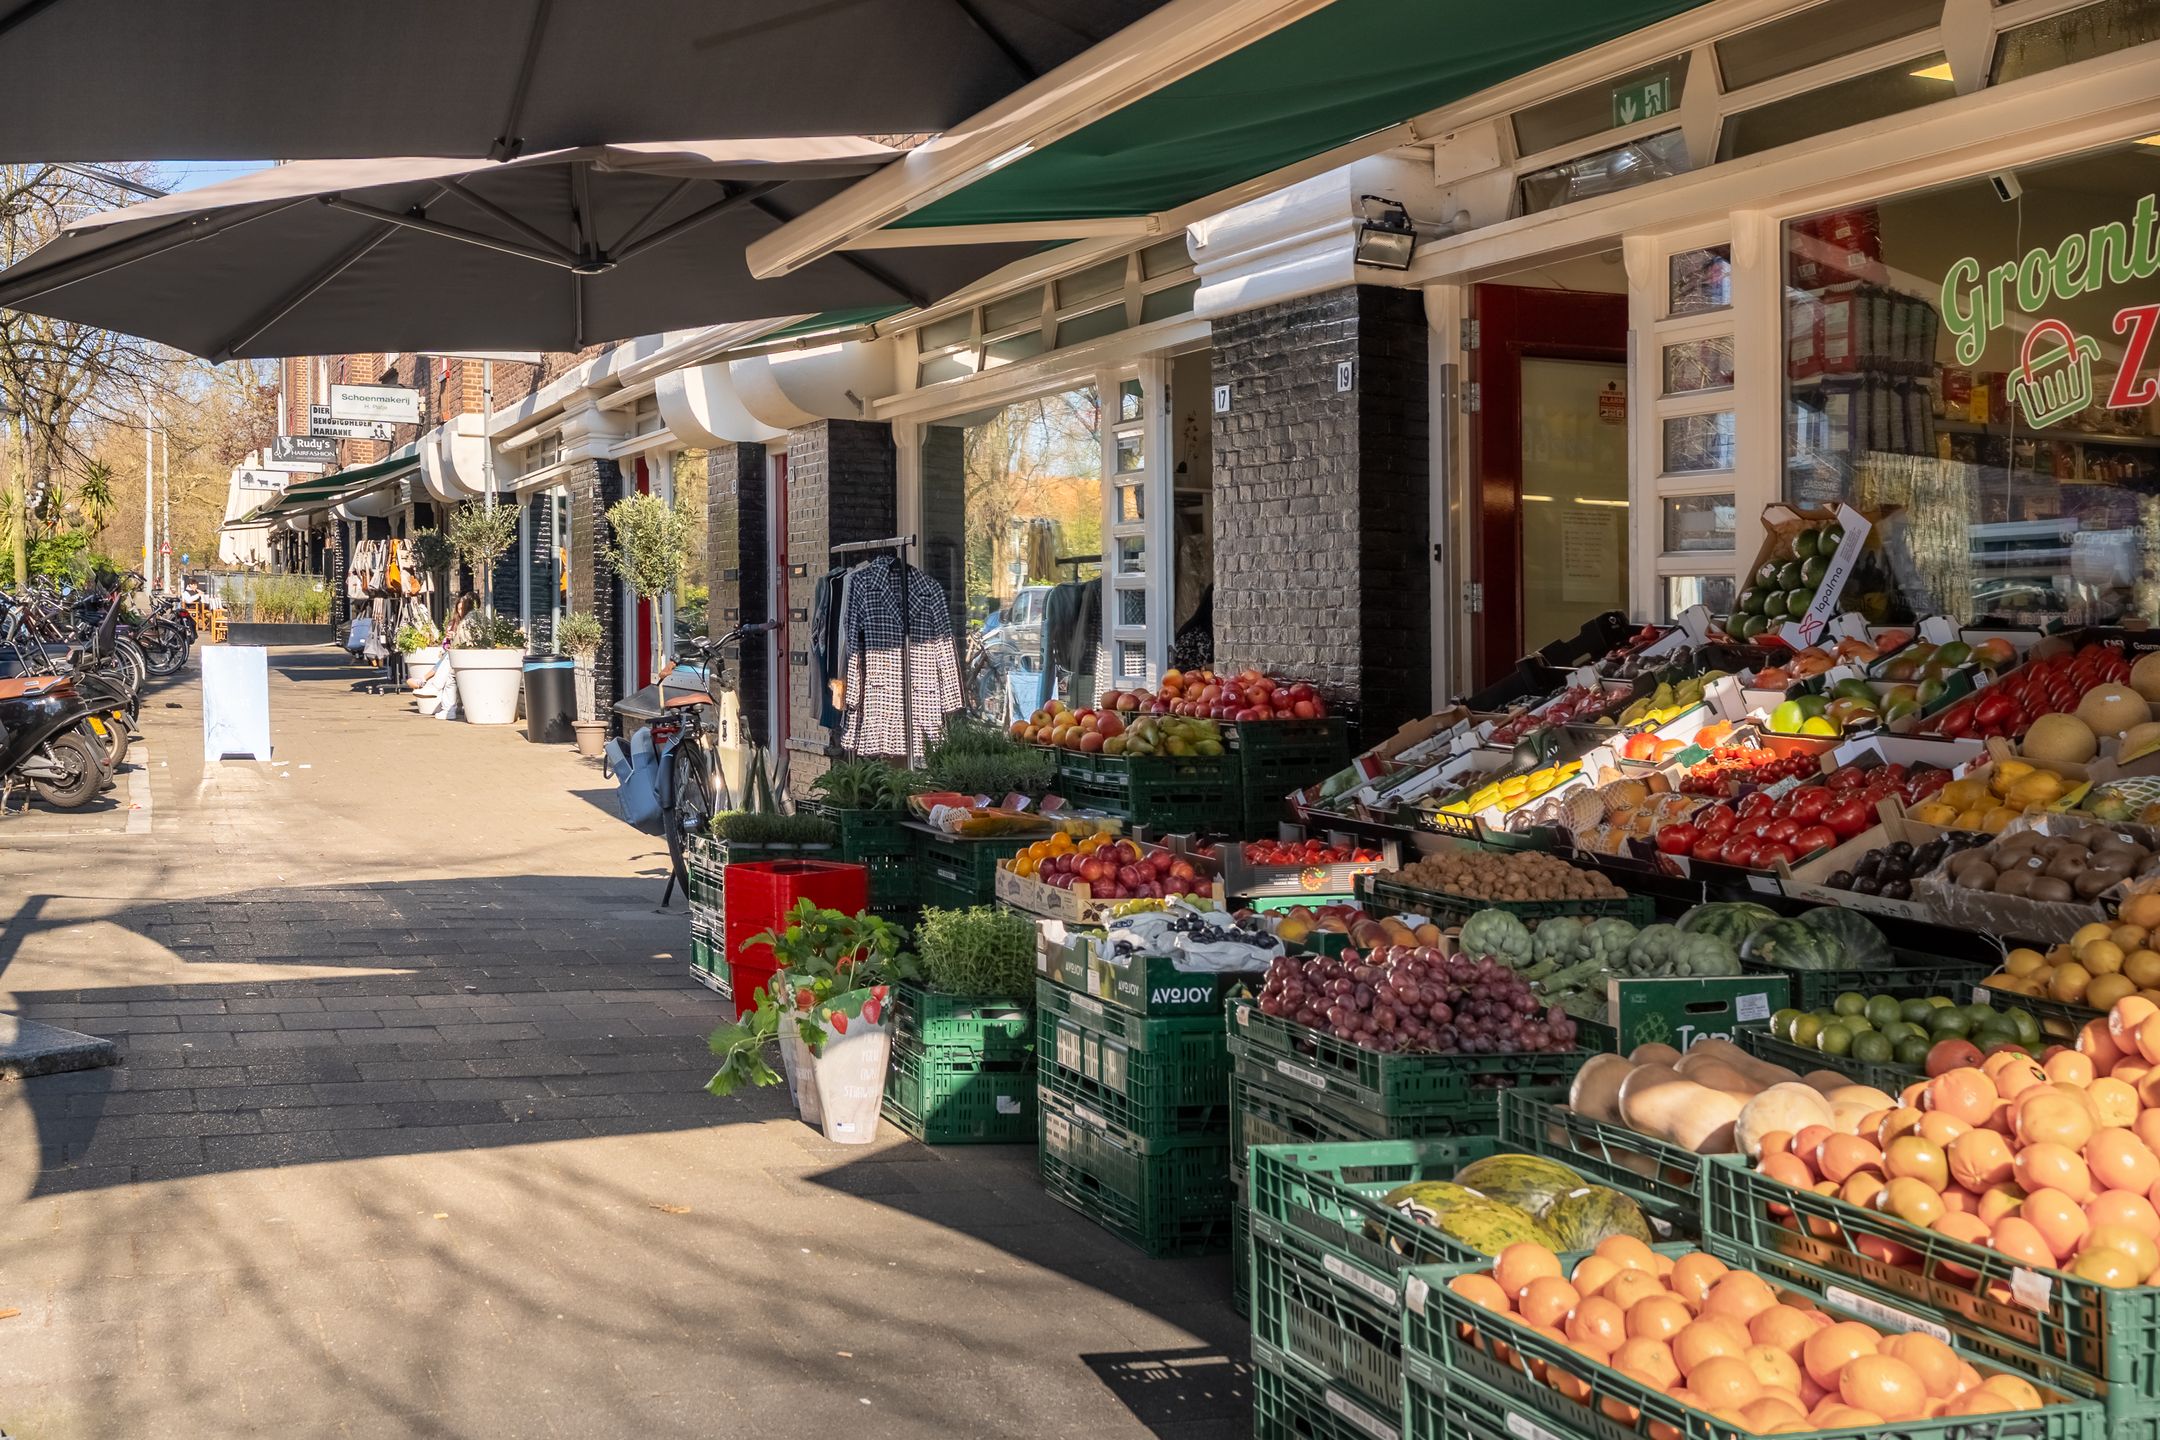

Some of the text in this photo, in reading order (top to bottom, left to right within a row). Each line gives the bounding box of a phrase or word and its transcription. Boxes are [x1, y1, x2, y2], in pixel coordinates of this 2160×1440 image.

[1941, 193, 2160, 367] Groent
[2106, 303, 2160, 409] Z
[1340, 367, 1349, 388] 19
[341, 393, 411, 406] Schoenmakerij
[1218, 390, 1226, 409] 17
[312, 406, 330, 415] DIER
[312, 428, 352, 437] MARIANNE
[296, 438, 331, 450] Rudy's
[1815, 567, 1843, 613] lapalma
[1065, 961, 1084, 976] AVOJOY
[1118, 980, 1140, 997] AVOJOY
[1151, 987, 1213, 1004] AVOJOY
